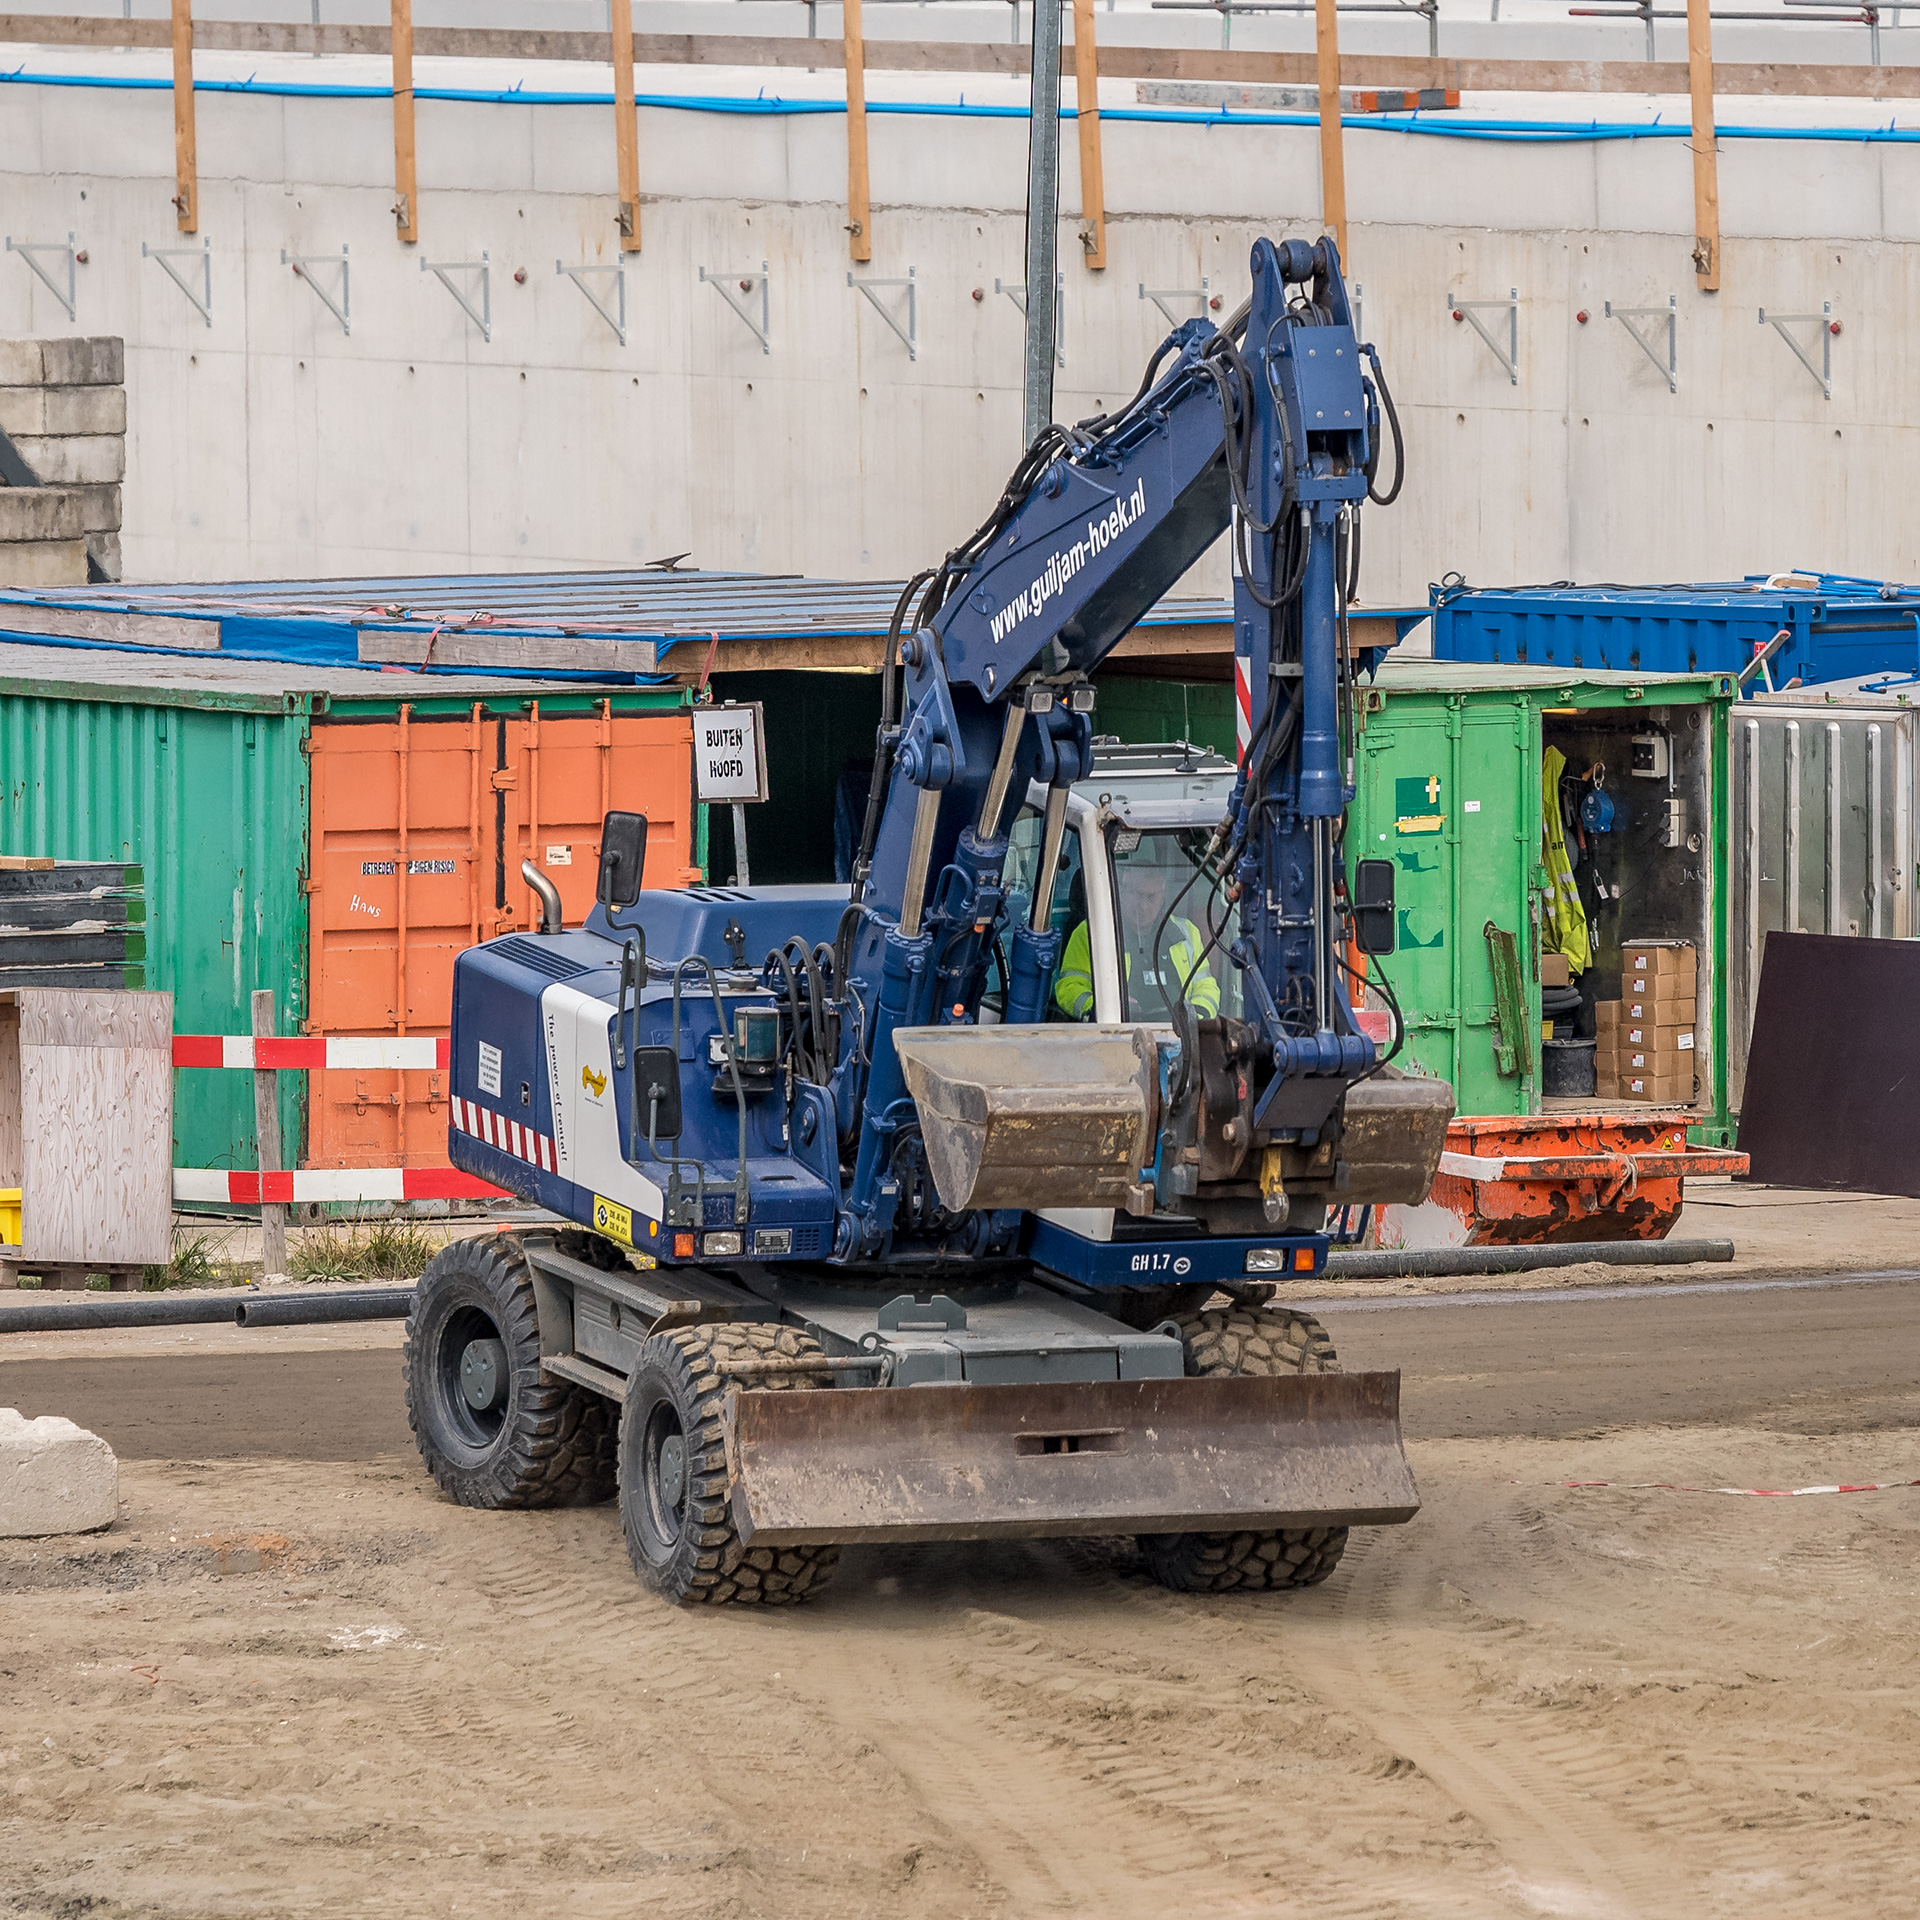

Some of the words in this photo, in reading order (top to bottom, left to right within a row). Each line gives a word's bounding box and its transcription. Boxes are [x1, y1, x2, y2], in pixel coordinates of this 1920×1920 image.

[990, 477, 1146, 645] www.guiljam-hoek.nl
[705, 728, 743, 748] BUITEN
[709, 760, 743, 778] HOOFD
[362, 862, 395, 874] BETREDEN
[549, 1044, 559, 1087] power
[555, 1092, 562, 1106] of
[1131, 1254, 1149, 1271] GH
[1152, 1253, 1171, 1270] 1.7
